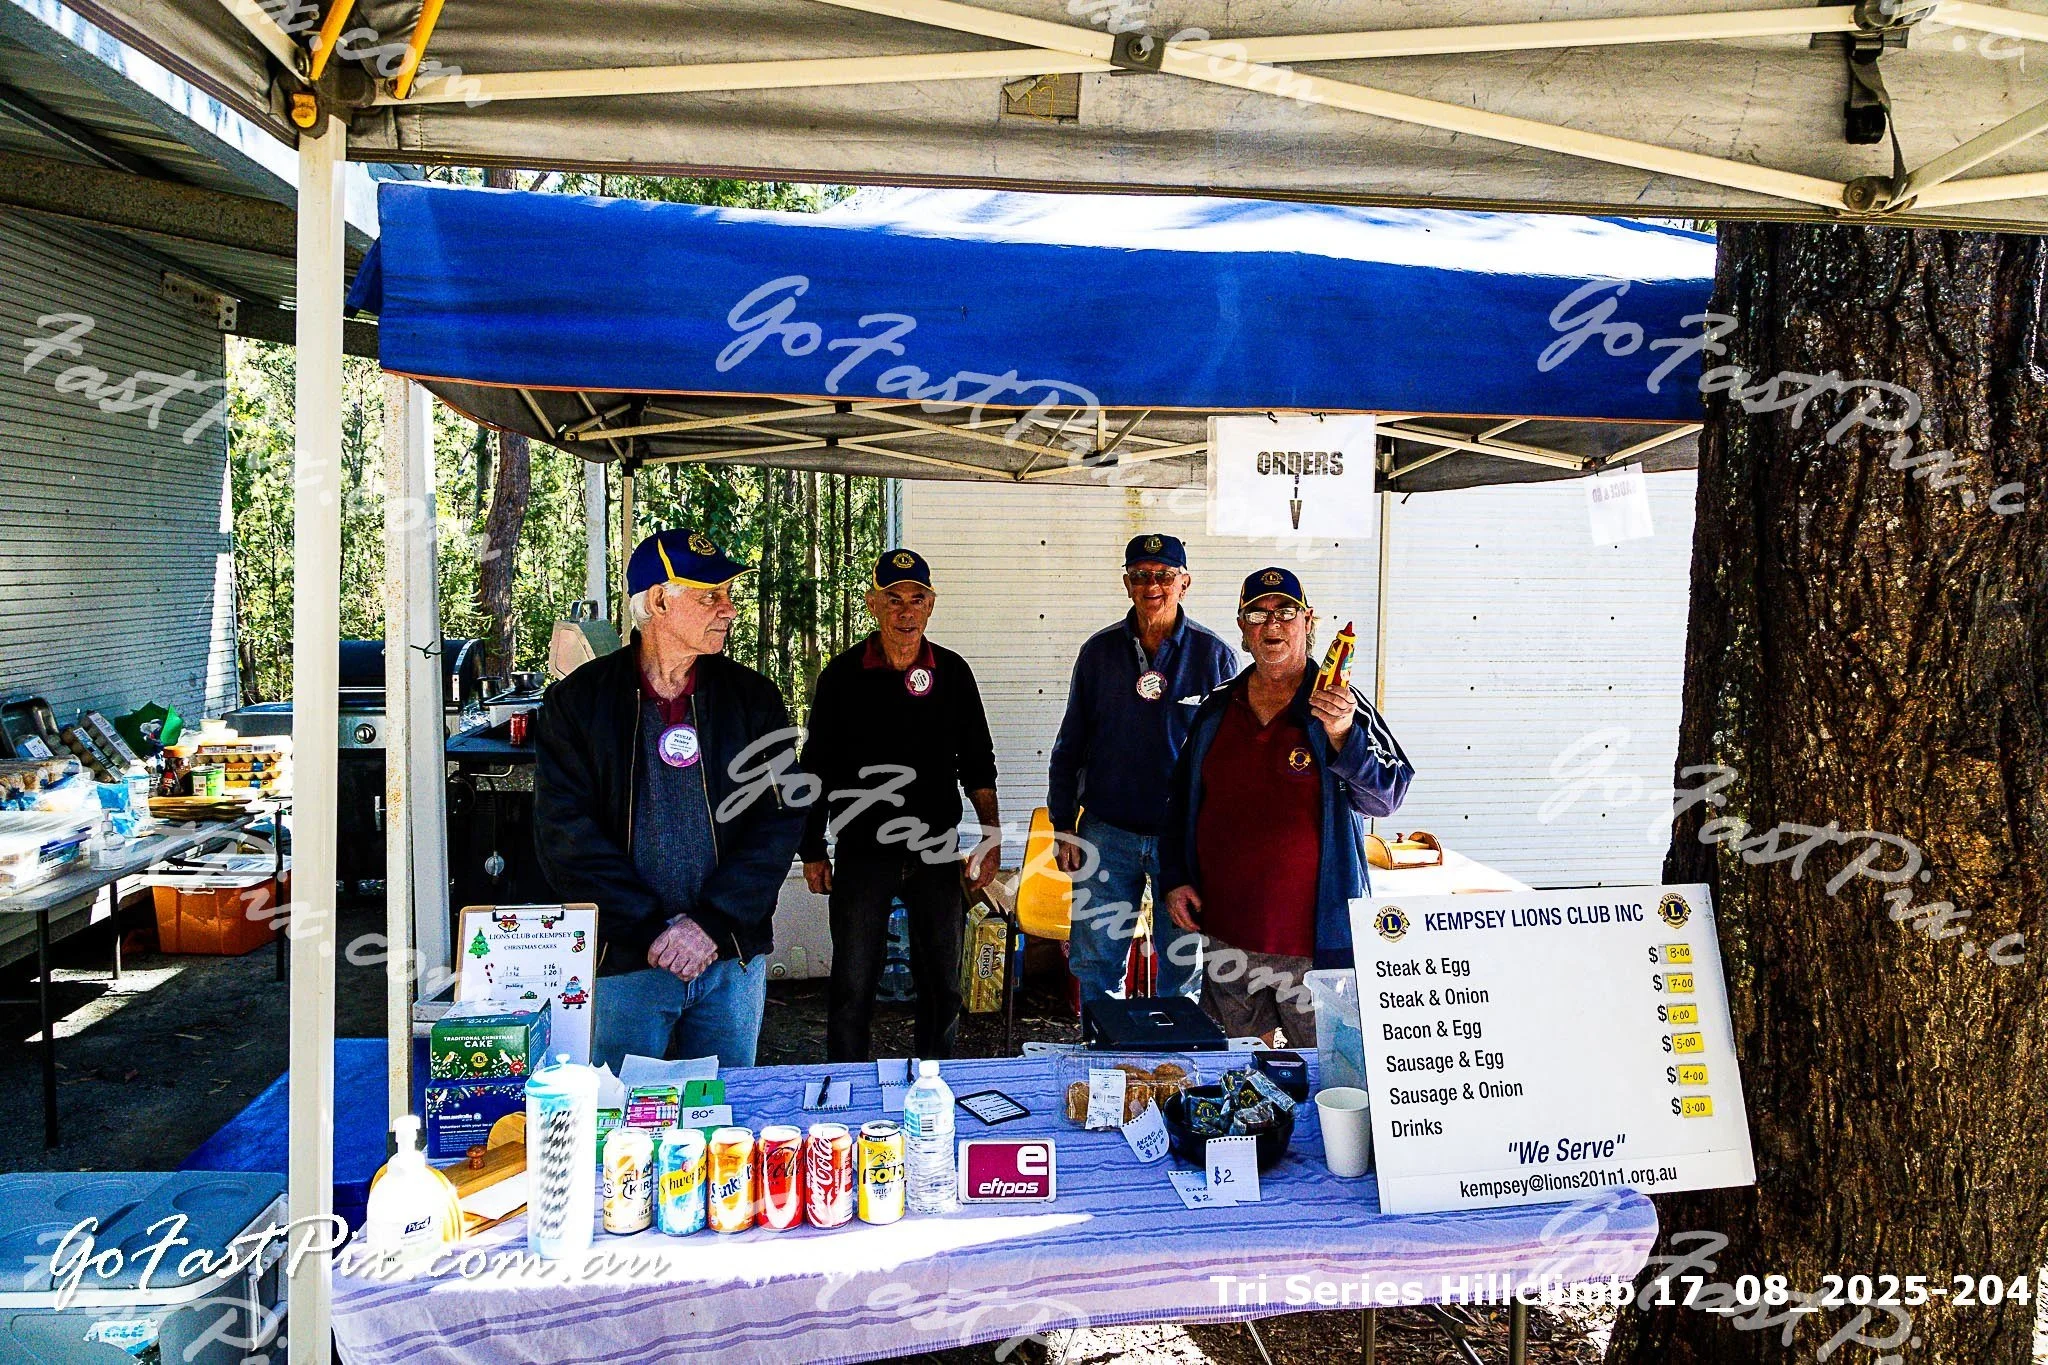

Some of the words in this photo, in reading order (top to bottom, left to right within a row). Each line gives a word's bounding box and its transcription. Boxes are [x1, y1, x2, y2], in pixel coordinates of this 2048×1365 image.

[1257, 451, 1344, 475] ORDERS
[1425, 910, 1506, 931] KEMPSEY
[1511, 908, 1562, 927] LIONS
[1567, 905, 1611, 925] CLUB
[1615, 903, 1644, 922] INC
[539, 931, 572, 939] KEMPSEY
[982, 947, 992, 976] KIRKS
[1648, 946, 1659, 964] $
[1376, 959, 1421, 978] Steak
[1425, 958, 1437, 975] &
[1441, 957, 1471, 977] Egg
[1652, 974, 1663, 992] $
[1379, 990, 1425, 1009] Steak
[1429, 989, 1441, 1006] &
[1445, 988, 1489, 1005] Onion
[1657, 1004, 1668, 1022] $
[1383, 1023, 1431, 1041] Bacon
[1436, 1020, 1448, 1037] &
[1452, 1019, 1482, 1040] Egg
[464, 1040, 493, 1048] CAKE
[1662, 1034, 1672, 1053] $
[1386, 1054, 1454, 1073] Sausage
[1458, 1051, 1470, 1068] &
[1475, 1050, 1505, 1070] Egg
[1666, 1065, 1677, 1084] $
[1389, 1085, 1458, 1105] Sausage
[1462, 1083, 1475, 1100] &
[1478, 1081, 1523, 1099] Onion
[1671, 1096, 1682, 1116] $
[1391, 1118, 1443, 1138] Drinks
[1508, 1141, 1550, 1165] "We
[1556, 1133, 1626, 1163] Serve"
[1214, 1166, 1235, 1186] $2
[1460, 1165, 1678, 1199] kempsey@lions201n1.org.au
[978, 1178, 1040, 1197] eftpos
